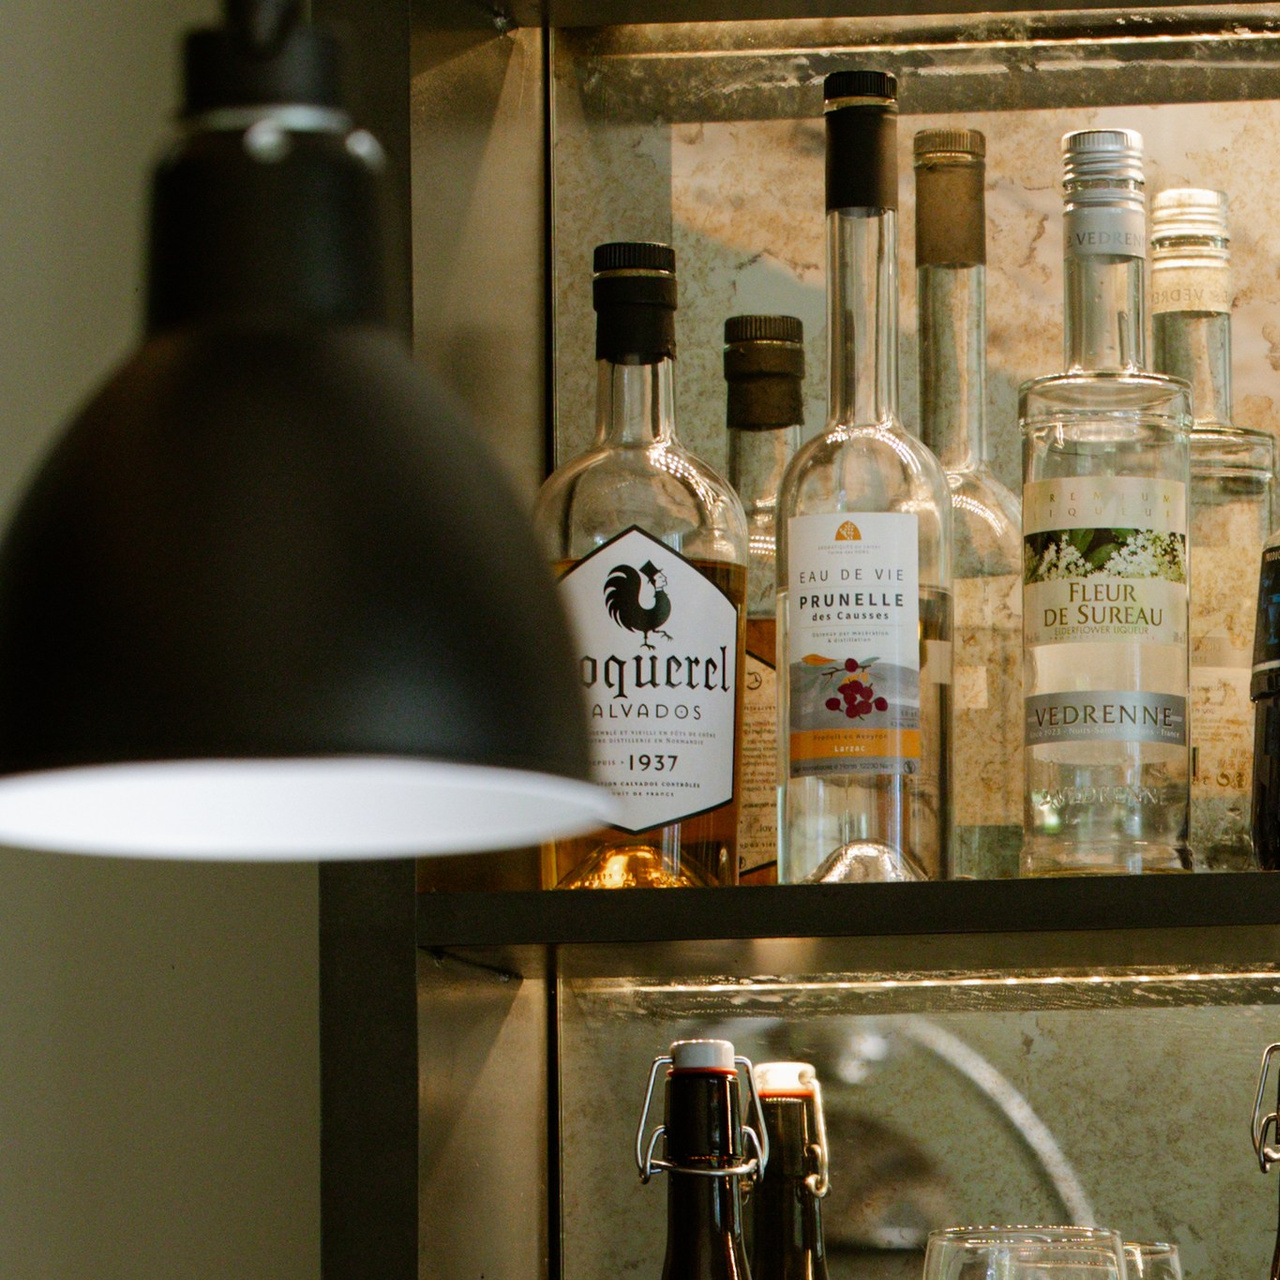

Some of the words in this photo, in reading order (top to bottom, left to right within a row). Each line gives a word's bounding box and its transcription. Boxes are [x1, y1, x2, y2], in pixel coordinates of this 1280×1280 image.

[800, 570, 829, 584] EAU
[841, 568, 863, 581] DE
[875, 568, 904, 582] VIE
[1069, 582, 1137, 602] FLEUR
[800, 593, 904, 610] PRUNELLE
[812, 612, 831, 622] des
[837, 611, 889, 620] Causses
[1044, 607, 1069, 627] DE
[1077, 604, 1163, 627] SUREAU
[592, 703, 702, 721] ALVADOS
[1035, 704, 1173, 728] VEDRENNE
[834, 745, 866, 753] Larzac
[629, 754, 679, 772] 1937
